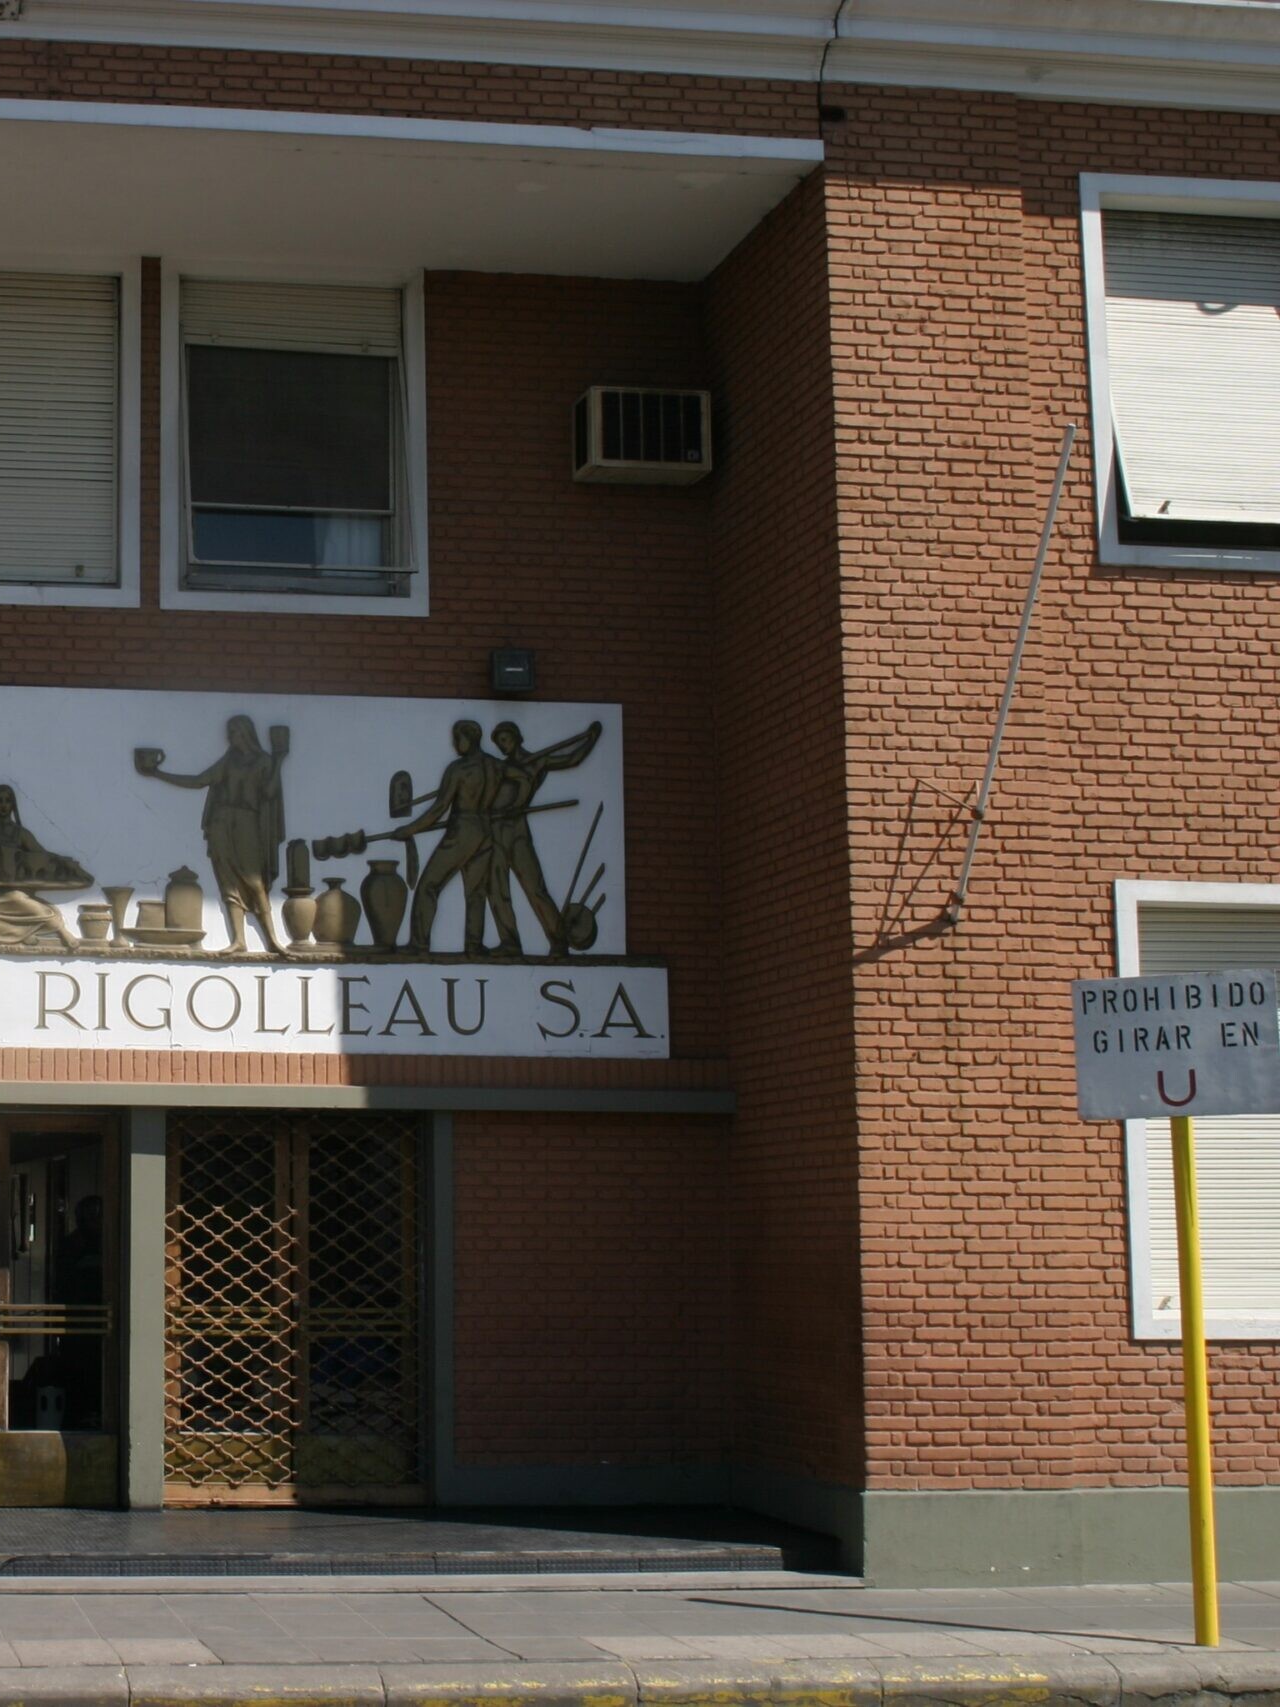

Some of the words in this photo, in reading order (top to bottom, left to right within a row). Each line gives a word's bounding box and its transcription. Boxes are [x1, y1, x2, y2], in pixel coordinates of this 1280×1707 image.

[34, 970, 489, 1036] RIGOLLEAU
[536, 979, 666, 1041] S.A.
[1081, 981, 1265, 1015] PROHIBIDO
[1093, 1025, 1192, 1053] GIRAR
[1221, 1021, 1260, 1048] EN
[1157, 1068, 1197, 1107] U
